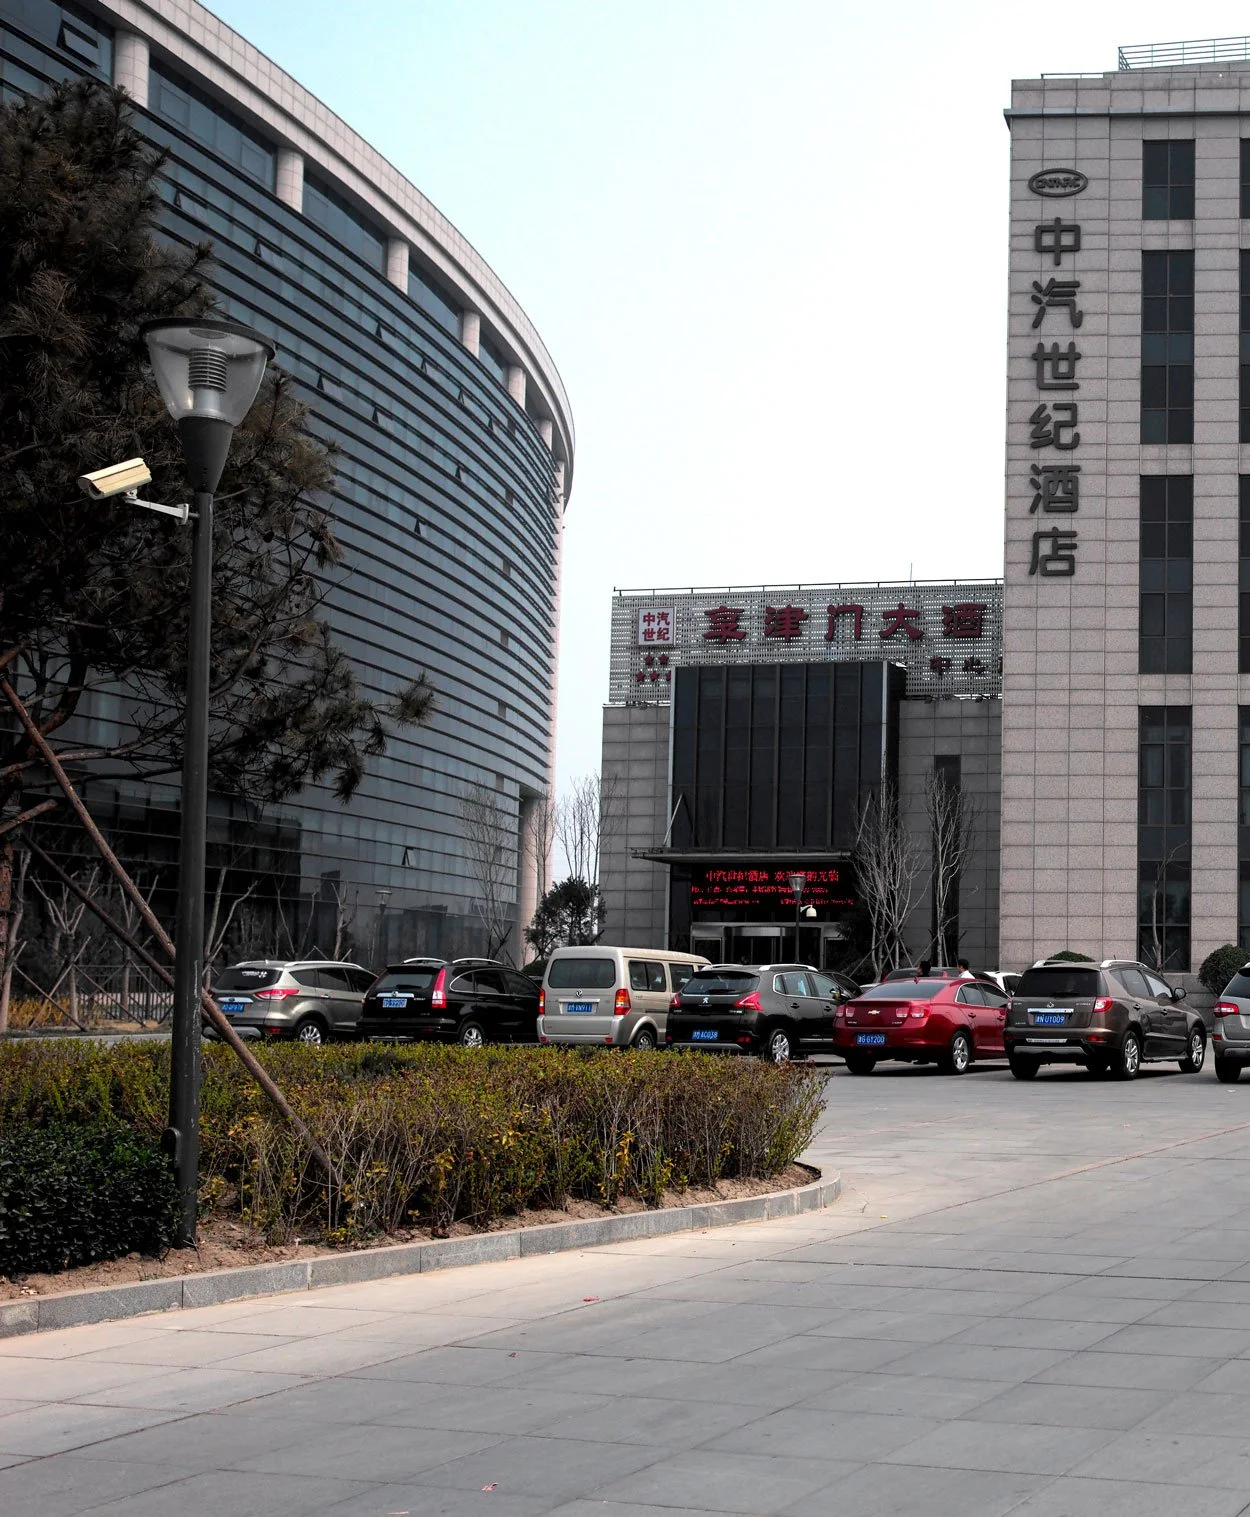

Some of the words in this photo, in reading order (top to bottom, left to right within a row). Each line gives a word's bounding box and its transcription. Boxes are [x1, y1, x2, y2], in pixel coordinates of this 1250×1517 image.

[1029, 217, 1083, 577] 中汽世纪酒店
[642, 611, 670, 627] 中汽
[642, 627, 670, 642] 世纪
[929, 656, 1003, 677] 中心
